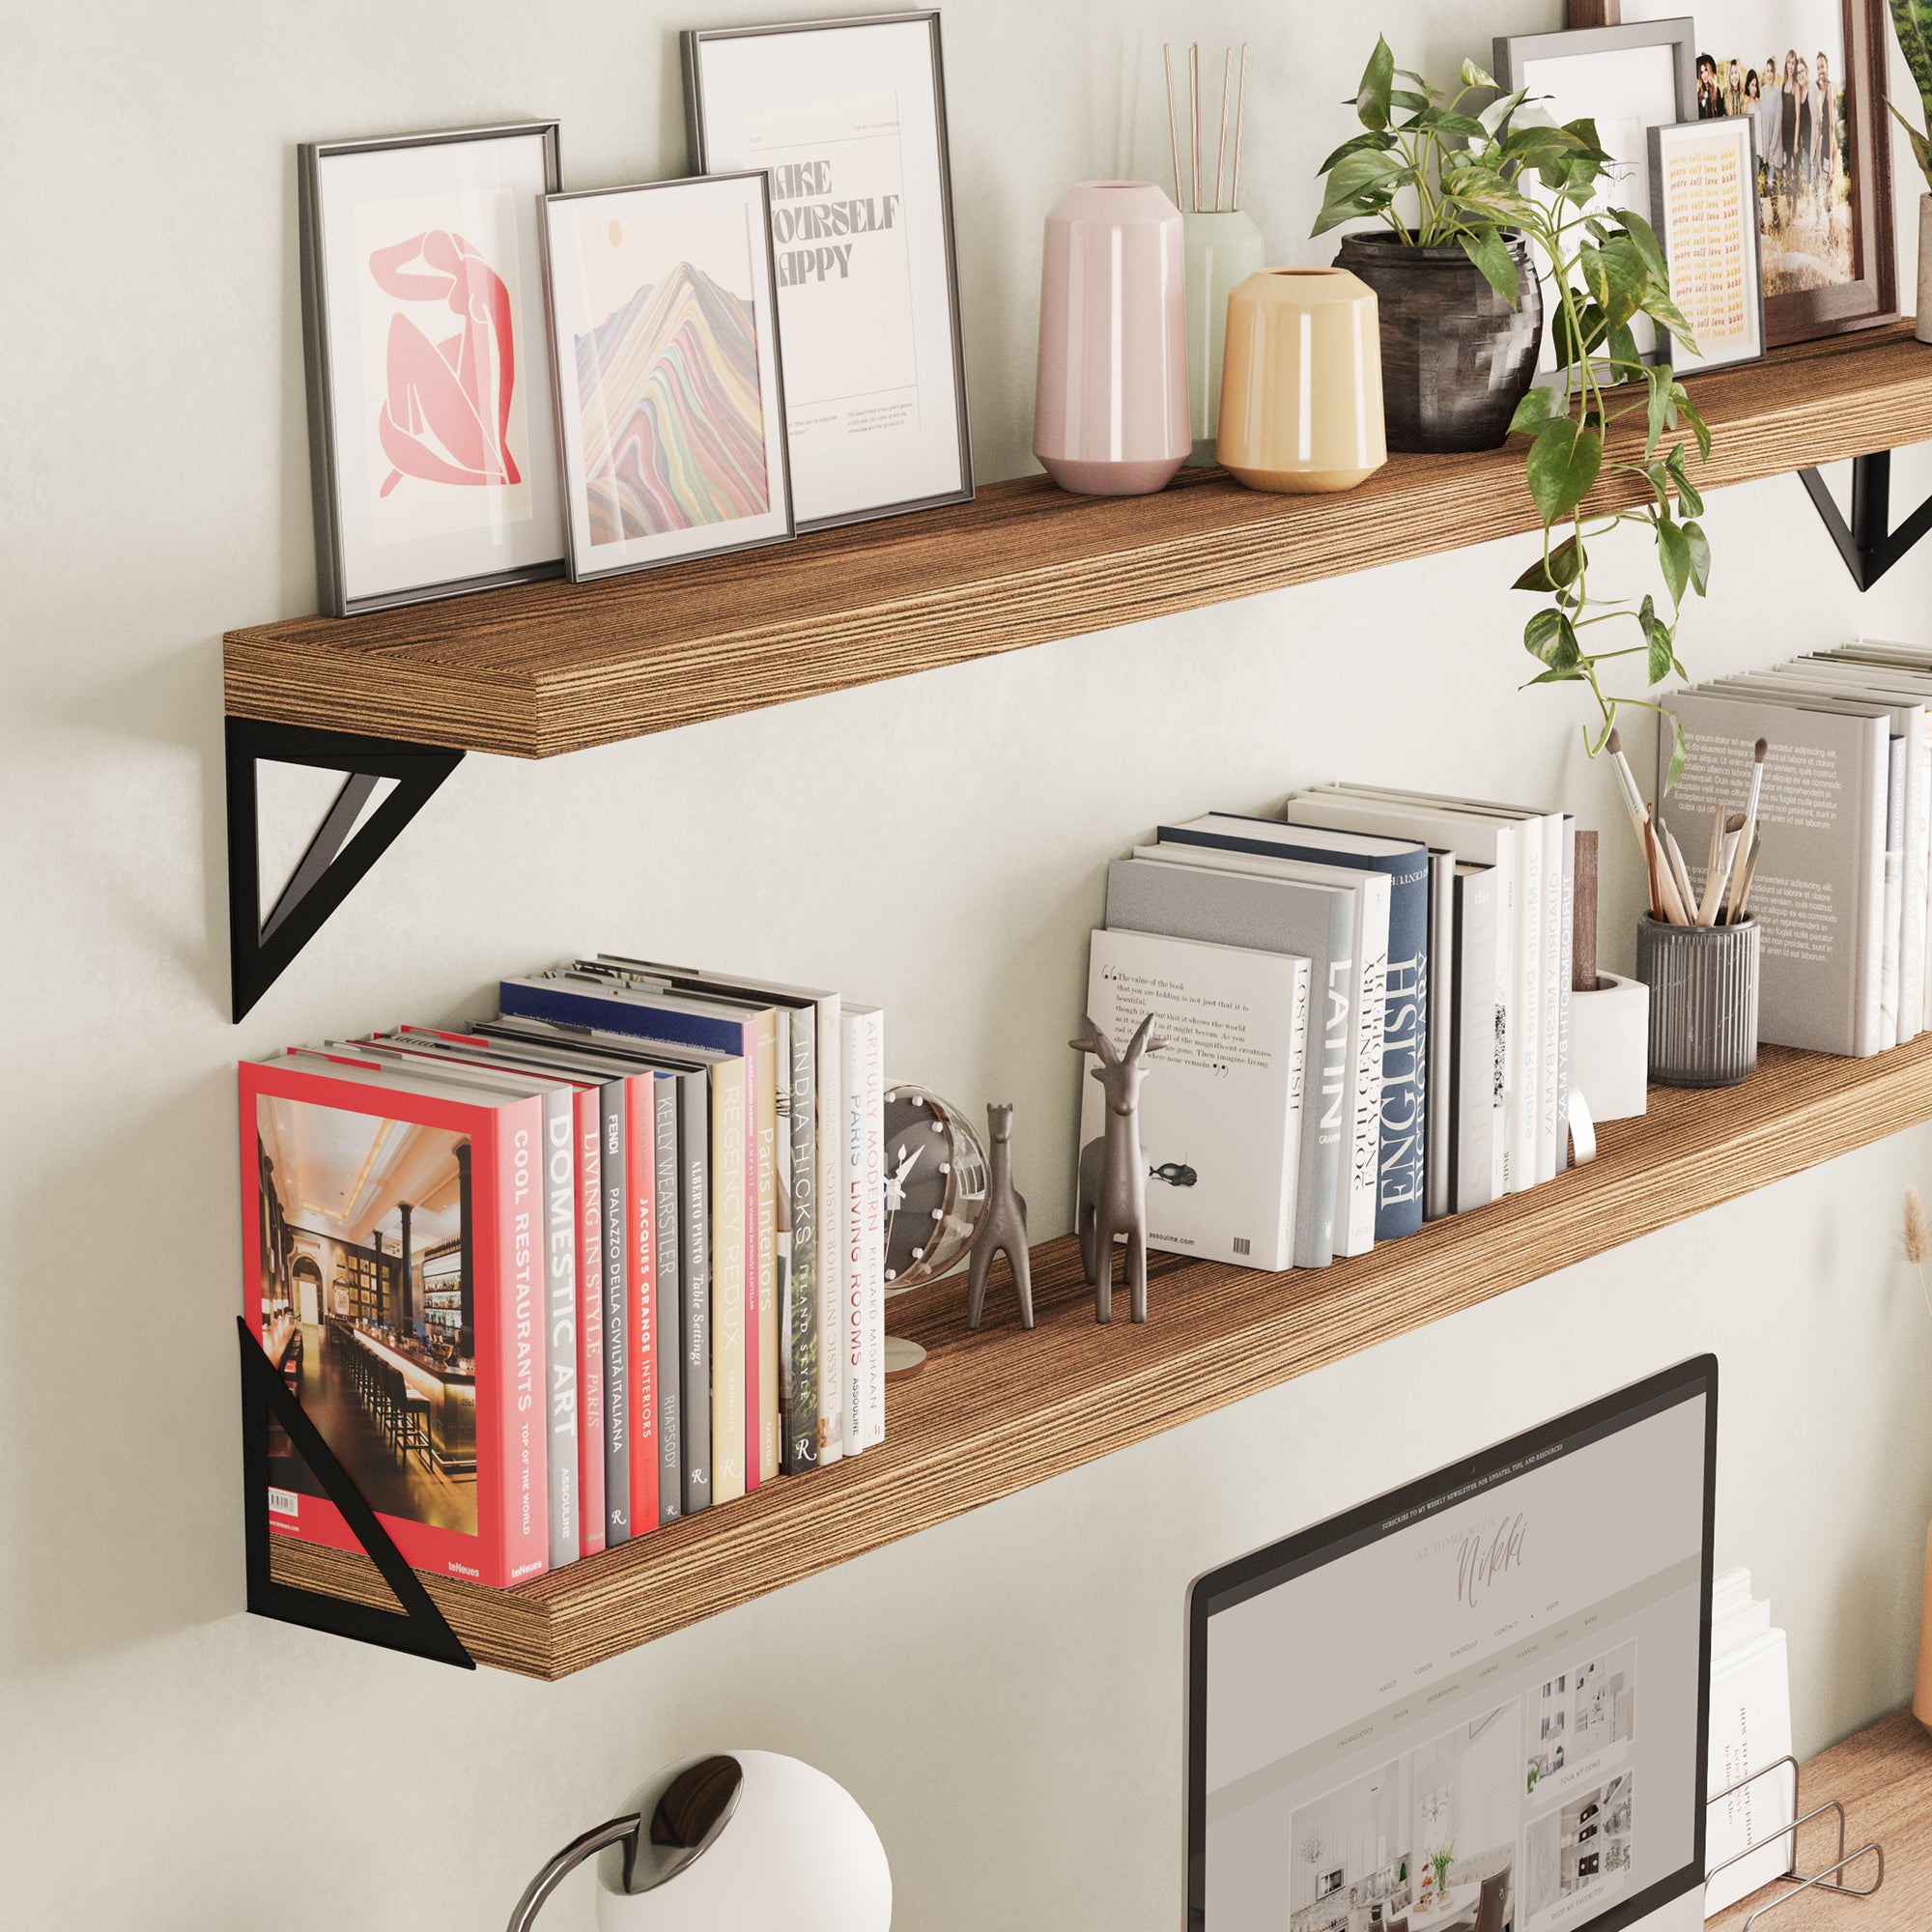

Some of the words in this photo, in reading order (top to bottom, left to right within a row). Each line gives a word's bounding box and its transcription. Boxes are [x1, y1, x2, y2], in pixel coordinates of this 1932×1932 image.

[768, 160, 832, 201] AKE
[1705, 177, 1718, 186] love
[1722, 172, 1736, 184] baby
[1707, 212, 1719, 221] love
[1724, 208, 1738, 219] baby
[772, 194, 900, 244] OURSELF
[776, 243, 852, 288] APPY
[1474, 891, 1490, 905] the
[1755, 875, 1789, 885] consectetur
[1790, 880, 1821, 892] adipiscing
[1783, 889, 1803, 898] labore
[1812, 892, 1831, 902] dolore
[1809, 903, 1832, 912] nostrud
[1117, 973, 1130, 981] The
[1156, 990, 1180, 1001] holding
[1295, 968, 1307, 1039] LOST
[1194, 1040, 1238, 1052] magnificent
[1239, 1047, 1272, 1057] creatures
[1196, 1049, 1215, 1059] Then
[1217, 1053, 1245, 1064] imagine
[1247, 1058, 1269, 1069] living
[1320, 959, 1352, 1129] LATIN
[1358, 959, 1374, 1095] CENTURY
[795, 1040, 810, 1132] INDIA
[867, 1022, 878, 1120] ARTFULLY
[1290, 1049, 1302, 1111] FISH
[1365, 953, 1386, 1186] ENCYCLOPEDIA
[1380, 956, 1418, 1210] ENGLISH
[1415, 951, 1427, 1200] DICTIONARY
[608, 1114, 619, 1155] FENDI
[657, 1096, 673, 1151] KELLY
[725, 1086, 740, 1232] REGENCY
[851, 1095, 861, 1167] PARIS
[514, 1129, 528, 1204] COOL
[584, 1131, 600, 1226] LIVING
[692, 1161, 702, 1218] ALBERTO
[759, 1128, 773, 1193] Paris
[795, 1143, 811, 1244] HICKS
[867, 1131, 879, 1232] MODERN
[549, 1114, 574, 1347] DOMESTIC
[610, 1188, 620, 1259] PALAZZO
[658, 1156, 676, 1276] WEARSTLER
[827, 1161, 838, 1233] DESIGN
[851, 1181, 861, 1262] LIVING
[586, 1236, 600, 1265] IN
[640, 1198, 649, 1275] JACQUES
[692, 1222, 703, 1263] PINTO
[759, 1200, 773, 1312] Interiors
[1149, 1232, 1195, 1245] assouline.com
[515, 1213, 532, 1412] RESTAURANTS
[586, 1275, 601, 1357] STYLE
[610, 1265, 621, 1315] DELLA
[641, 1283, 650, 1352] GRANGE
[693, 1275, 704, 1309] Table
[724, 1245, 740, 1351] REDUX
[827, 1240, 839, 1328] INTERIOR
[690, 1314, 704, 1367] Settings
[851, 1274, 862, 1366] ROOMS
[554, 1364, 575, 1437] ART
[587, 1374, 600, 1428] PARIS
[642, 1360, 651, 1438] INTERIORS
[827, 1333, 839, 1409] CLASSIC
[612, 1380, 622, 1453] ITALIANA
[665, 1395, 676, 1469] RHAPSODY
[522, 1450, 529, 1465] OF
[1382, 1513, 1409, 1530] SUBSCRIBE
[1418, 1505, 1426, 1514] MY
[1426, 1496, 1446, 1510] WEEKLY
[1447, 1482, 1477, 1501] NEWSLETTER
[1478, 1478, 1488, 1487] FOR
[1525, 1456, 1535, 1466] AND
[1536, 1444, 1563, 1461] RESOURCES
[561, 1468, 570, 1540] ASSOULINE
[1417, 1548, 1428, 1562] AT
[1434, 1532, 1463, 1553] HOME
[1469, 1516, 1495, 1536] WITH
[448, 1560, 480, 1577] teNeues
[511, 1560, 542, 1578] teNeues
[1457, 1512, 1528, 1608] Nikki
[1379, 1680, 1397, 1693] ABOUT
[1414, 1662, 1433, 1676] VIDEOS
[1494, 1621, 1518, 1637] CONTACT
[1559, 1774, 1575, 1786] TOUR
[1576, 1769, 1583, 1777] MY
[1585, 1760, 1601, 1772] HOME
[1551, 1907, 1565, 1921] SHOP
[1576, 1886, 1605, 1907] FAVORITES
